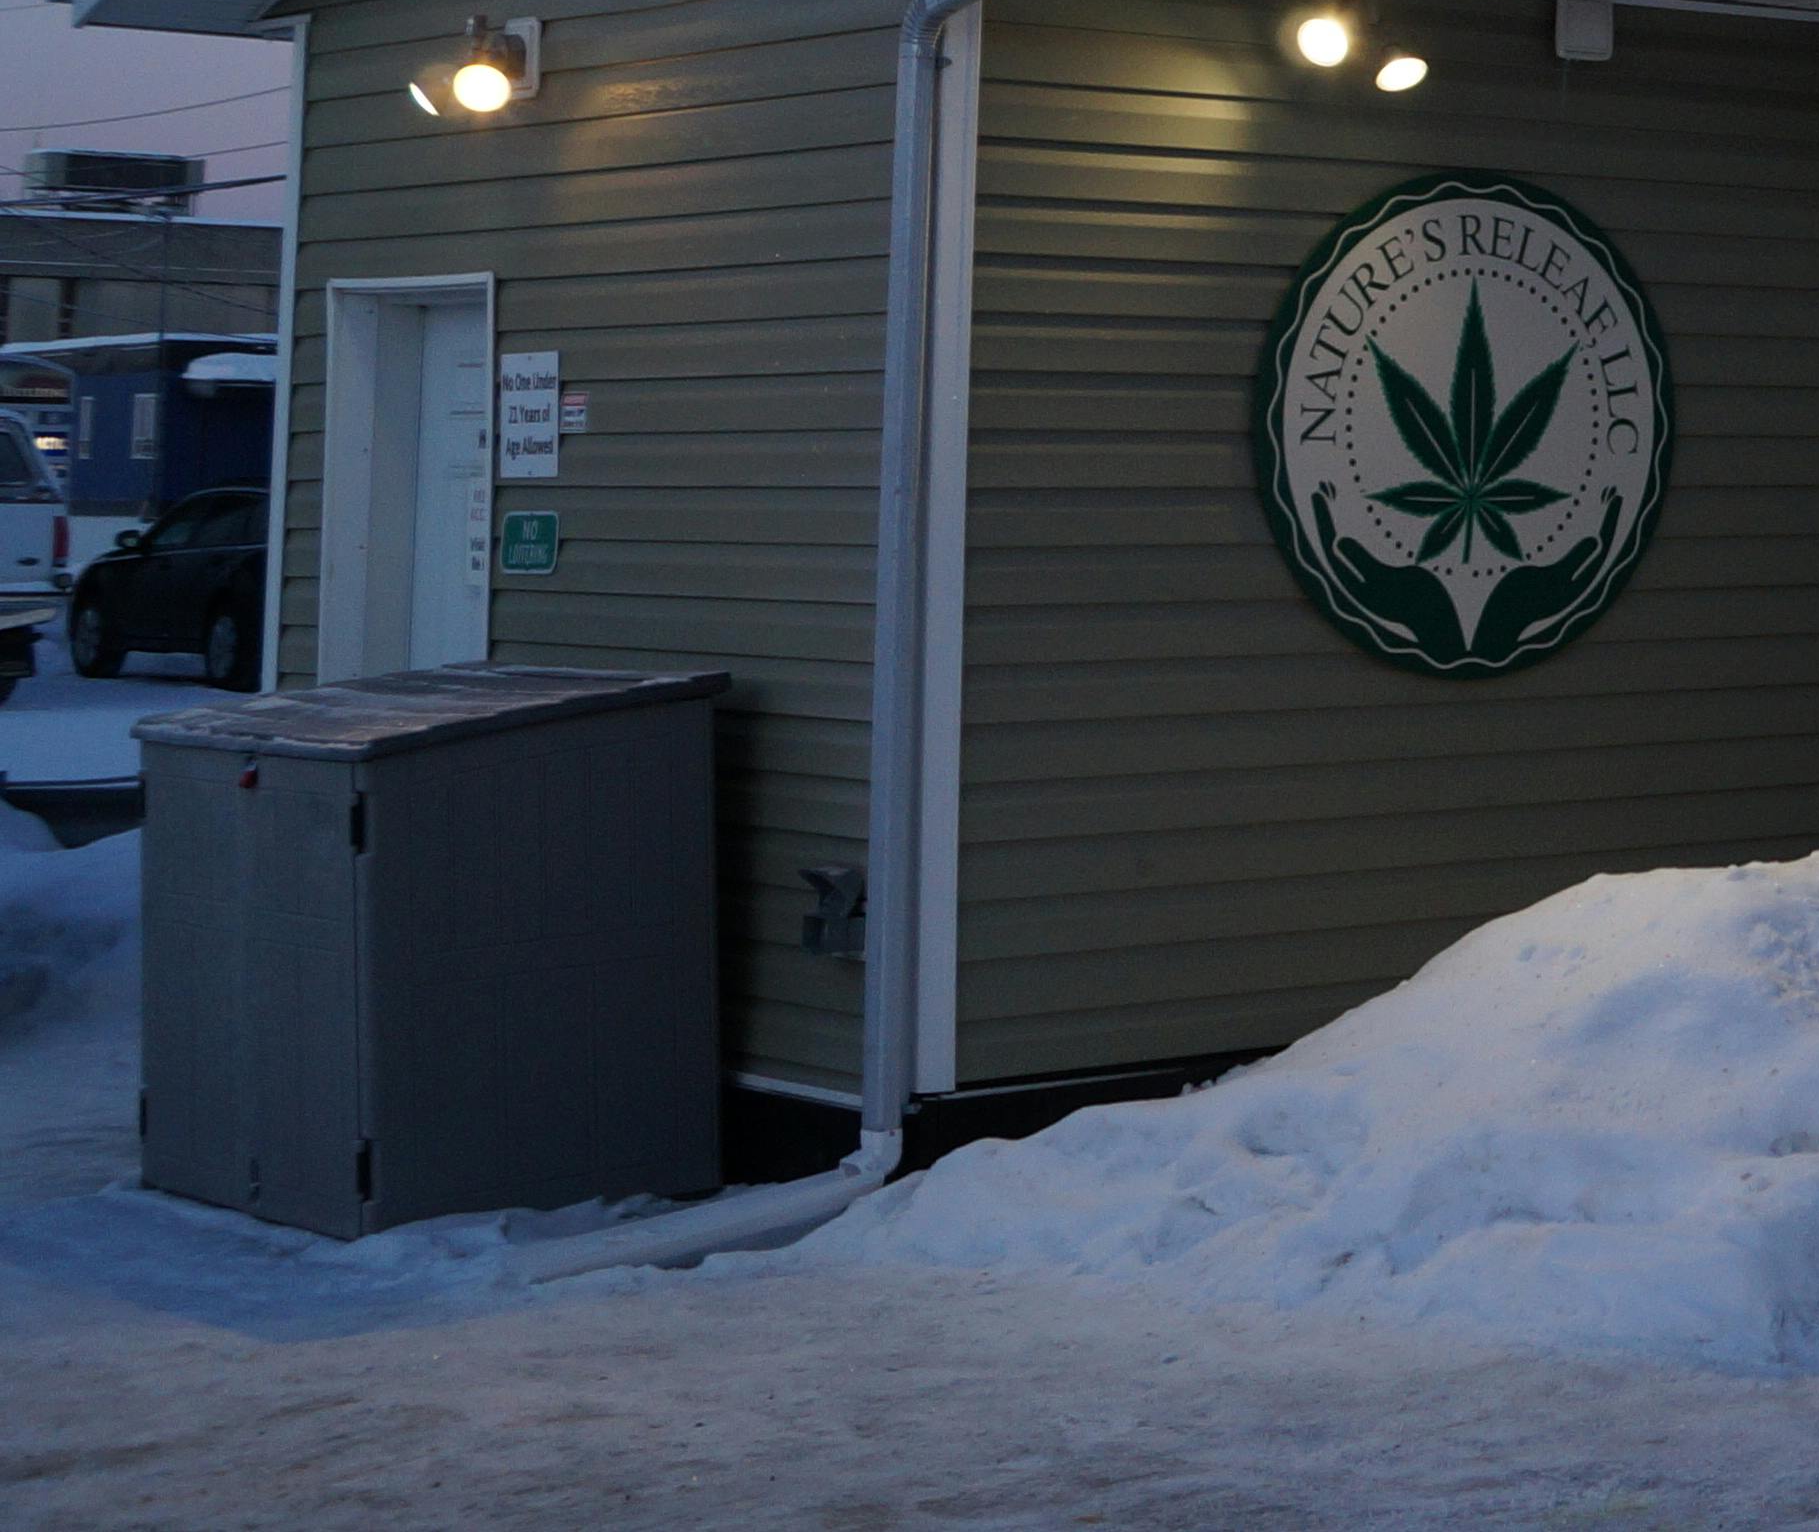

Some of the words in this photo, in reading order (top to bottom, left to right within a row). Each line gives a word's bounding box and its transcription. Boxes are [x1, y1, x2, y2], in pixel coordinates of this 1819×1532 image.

[1300, 218, 1446, 446] NATURE'S
[1456, 214, 1618, 348] RELEAF,
[1600, 344, 1639, 455] LLC
[502, 373, 514, 390] No
[515, 372, 531, 390] One
[532, 370, 557, 389] Under
[519, 404, 541, 423] Years
[542, 402, 551, 423] of
[505, 437, 521, 460] Age
[522, 435, 554, 455] Allowed
[522, 519, 539, 541] NO
